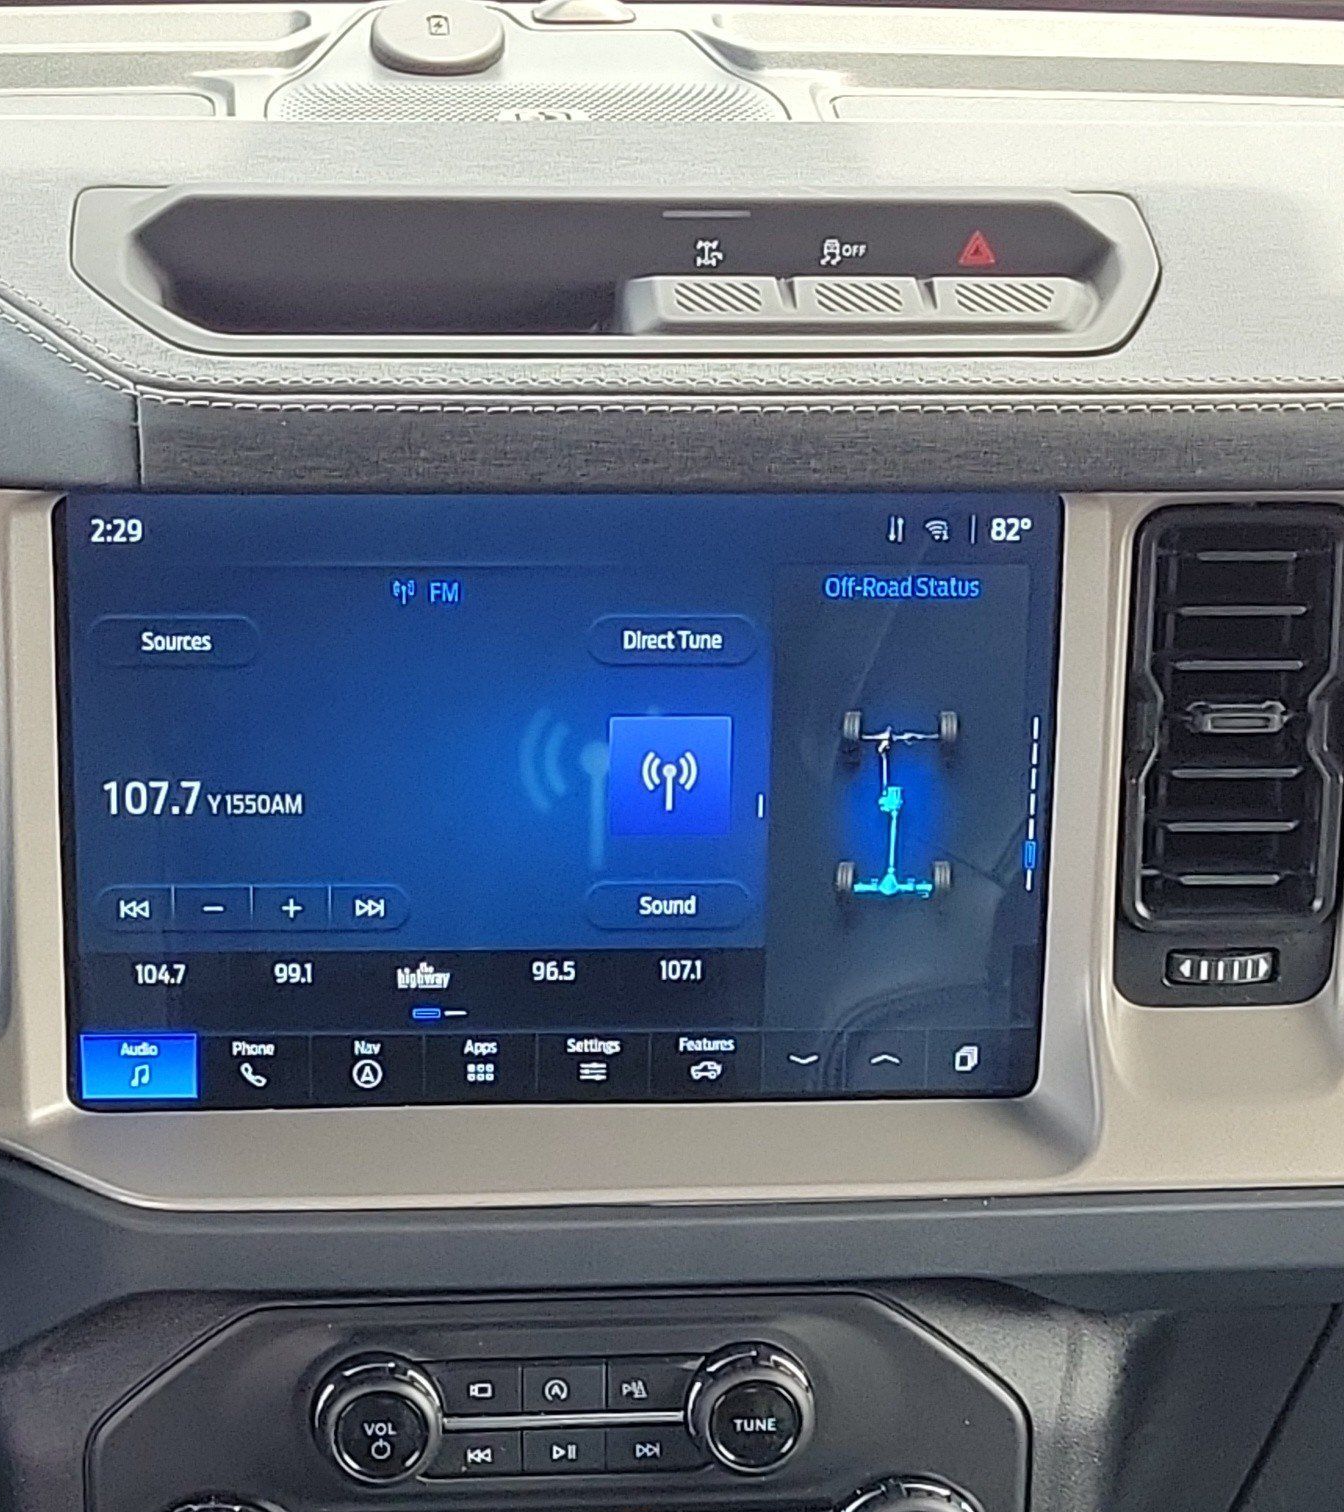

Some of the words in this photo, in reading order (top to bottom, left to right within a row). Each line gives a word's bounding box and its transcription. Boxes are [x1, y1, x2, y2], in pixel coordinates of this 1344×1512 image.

[842, 243, 867, 258] OFF
[90, 518, 143, 543] 2:29
[429, 582, 460, 603] FM
[824, 575, 912, 598] Off-Road
[916, 575, 980, 598] Status
[141, 631, 212, 653] Sources
[623, 629, 674, 651] Direct
[677, 629, 722, 651] Tune
[103, 781, 201, 815] 107.7
[639, 895, 697, 916] Sound
[135, 963, 186, 985] 104.7
[274, 963, 313, 984] 99.1
[397, 967, 451, 989] highway
[531, 960, 575, 981] 96.5
[659, 960, 702, 981] 107.1
[120, 1041, 158, 1056] Audio
[232, 1040, 274, 1056] Phone
[354, 1040, 380, 1056] Nav
[463, 1039, 498, 1057] Apps
[567, 1037, 621, 1055] Settings
[679, 1036, 735, 1052] Features
[363, 1422, 397, 1437] VOL
[732, 1417, 777, 1433] TUNE
